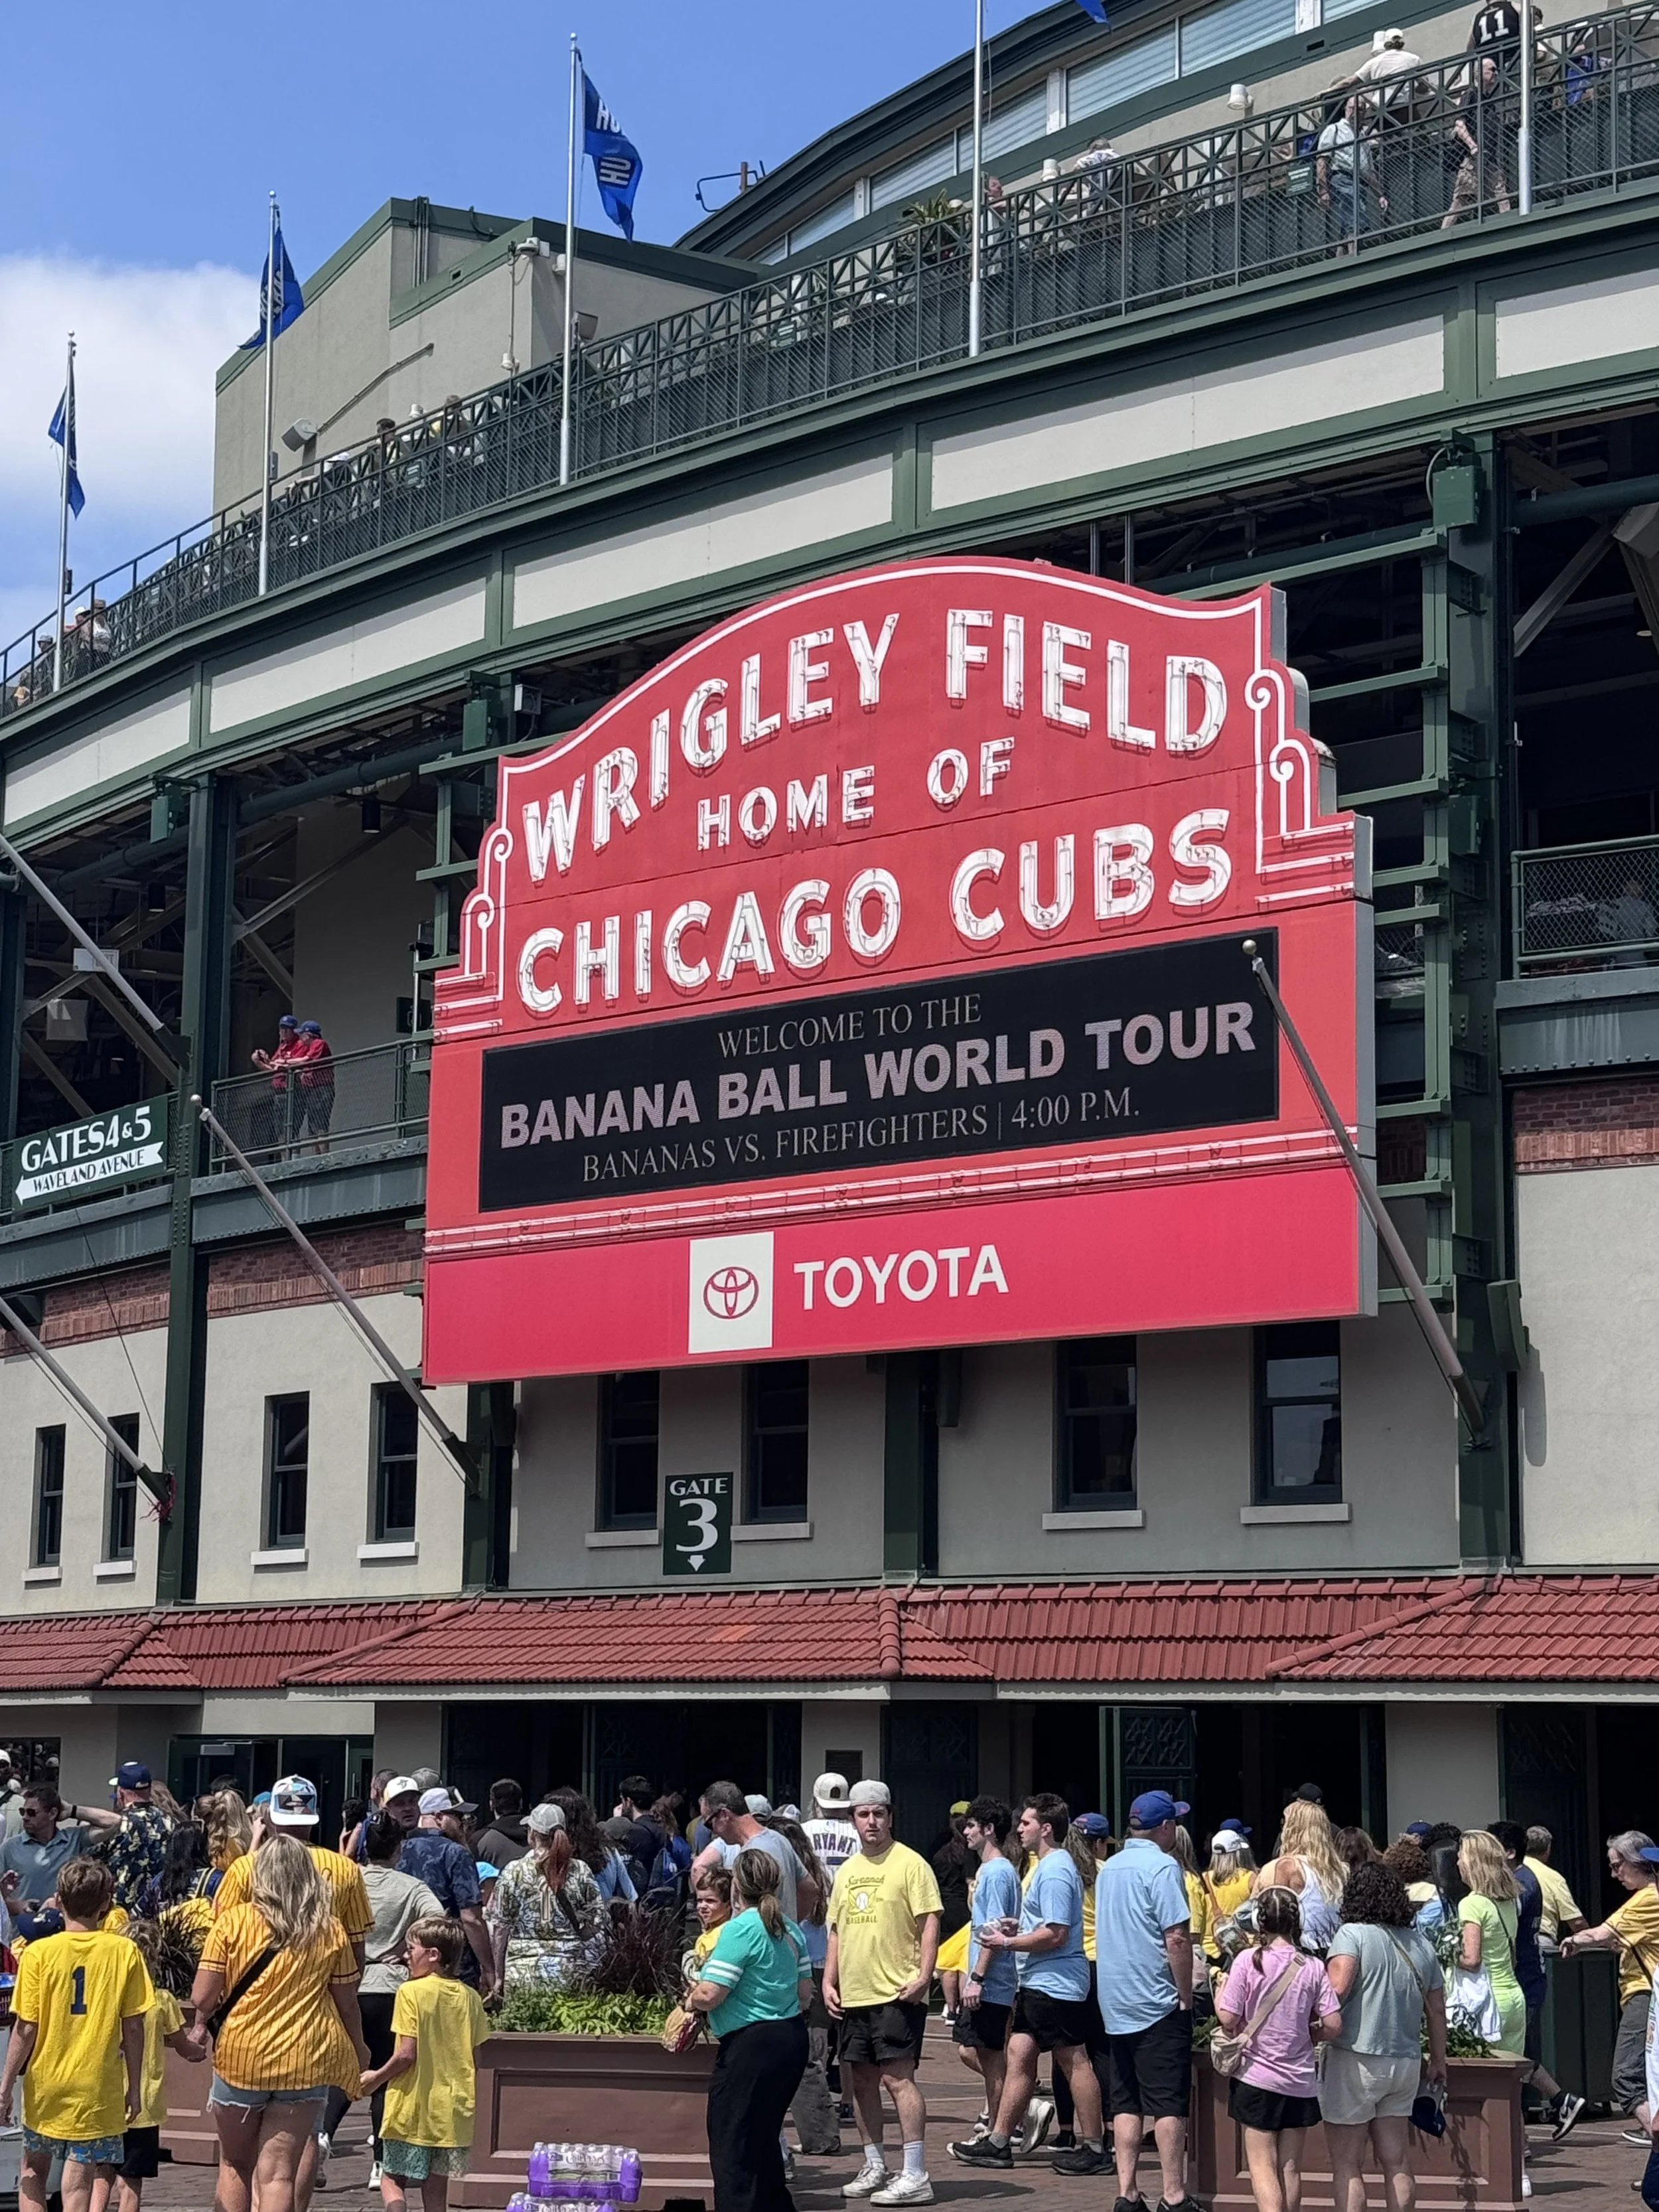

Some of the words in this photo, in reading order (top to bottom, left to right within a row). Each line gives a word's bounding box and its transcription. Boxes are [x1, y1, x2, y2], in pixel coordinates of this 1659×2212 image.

[1479, 9, 1509, 44] 11
[522, 613, 900, 883] WRIGLEY
[946, 609, 1228, 752] FIELD
[697, 765, 875, 851] HOME
[926, 737, 1015, 805] OF
[517, 867, 902, 1013] CHICAGO
[949, 808, 1232, 941] CUBS
[717, 1011, 865, 1059] WELCOME
[873, 1003, 912, 1037] TO
[921, 994, 982, 1030] THE
[501, 1080, 701, 1149] BANANA
[718, 1059, 848, 1120] BALL
[864, 1027, 1066, 1100] WORLD
[1084, 1001, 1256, 1070] TOUR
[582, 1139, 716, 1183] BANANAS
[724, 1133, 766, 1164] VS.
[776, 1104, 988, 1159] FIREFIGHTERS
[1011, 1094, 1070, 1130] 4:00
[1079, 1086, 1141, 1123] P.M.
[33, 1163, 96, 1193] WAVELAND
[99, 1149, 145, 1177] AVENUE
[793, 1244, 1009, 1311] TOYOTA
[670, 1477, 729, 1497] GATE
[676, 1498, 719, 1552] 3
[812, 1832, 857, 1854] RYANT
[70, 1966, 87, 2014] 1
